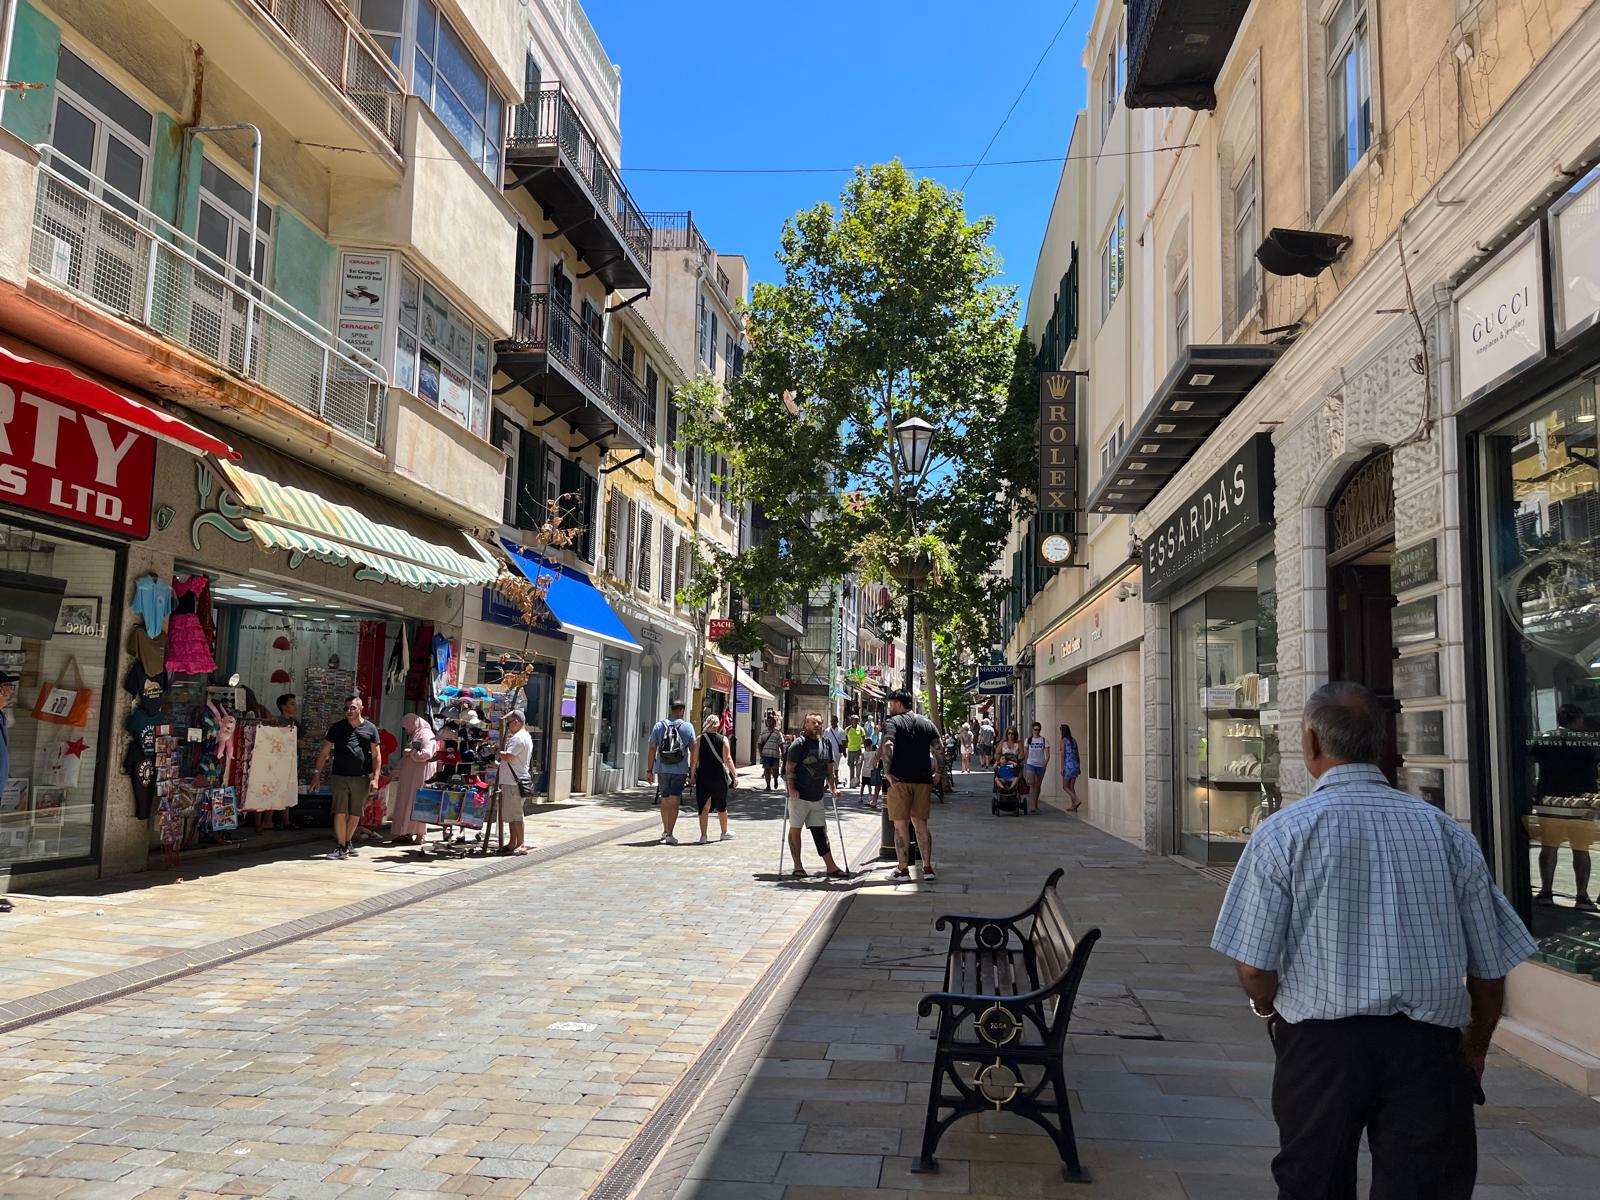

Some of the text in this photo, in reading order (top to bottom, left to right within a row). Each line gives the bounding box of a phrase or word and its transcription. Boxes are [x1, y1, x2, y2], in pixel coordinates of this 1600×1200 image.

[1473, 286, 1528, 342] GUCCI
[1048, 405, 1067, 508] ROLEX
[50, 478, 133, 526] LTD.
[1515, 481, 1600, 493] ZENIT
